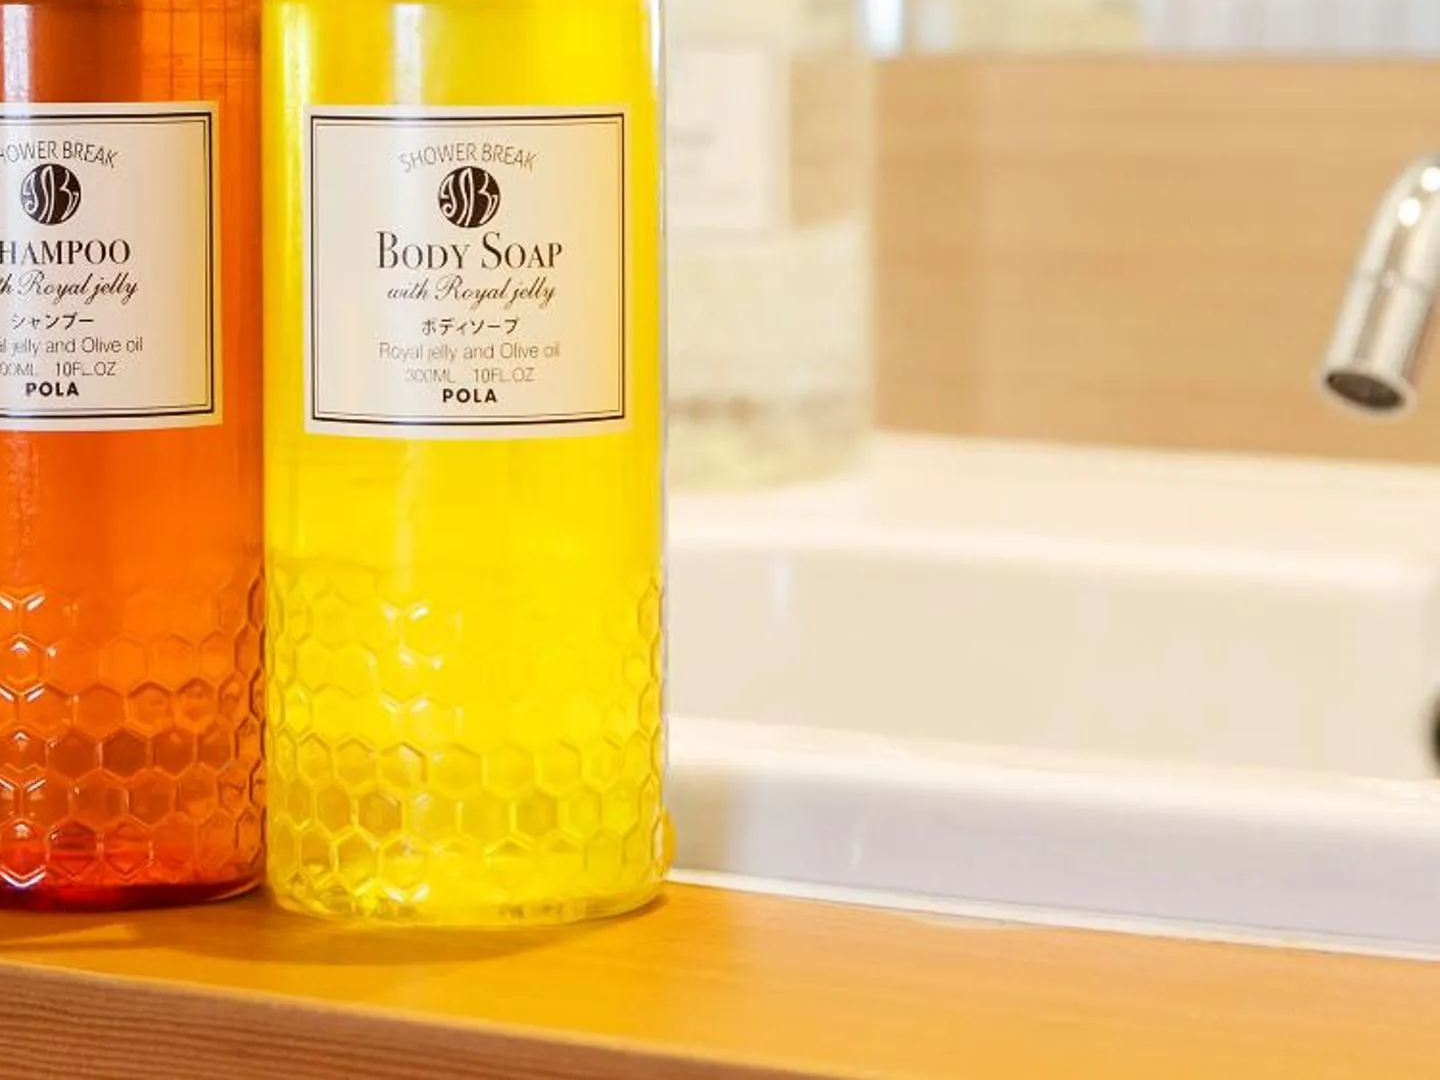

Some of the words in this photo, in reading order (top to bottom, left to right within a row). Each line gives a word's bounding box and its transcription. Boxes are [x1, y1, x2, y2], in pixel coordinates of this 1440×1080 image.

[63, 141, 119, 169] BREAK
[398, 143, 477, 172] SHOWER
[481, 143, 538, 170] BREAK
[376, 231, 470, 270] BODY
[481, 231, 562, 270] SOAP
[17, 270, 90, 305] Royal
[85, 272, 138, 305] jelly
[386, 276, 435, 300] with
[435, 274, 511, 310] Royal
[504, 276, 555, 310] jelly
[11, 312, 94, 330] シャンプー
[11, 338, 39, 356] jelly
[46, 338, 75, 353] and
[81, 337, 121, 354] Olive
[127, 337, 143, 352] oil
[379, 342, 423, 361] Royal
[427, 343, 457, 361] jelly
[463, 344, 494, 359] and
[500, 343, 538, 359] Olive
[543, 343, 559, 358] oil
[26, 382, 79, 397] POLA
[442, 388, 497, 403] POLA
